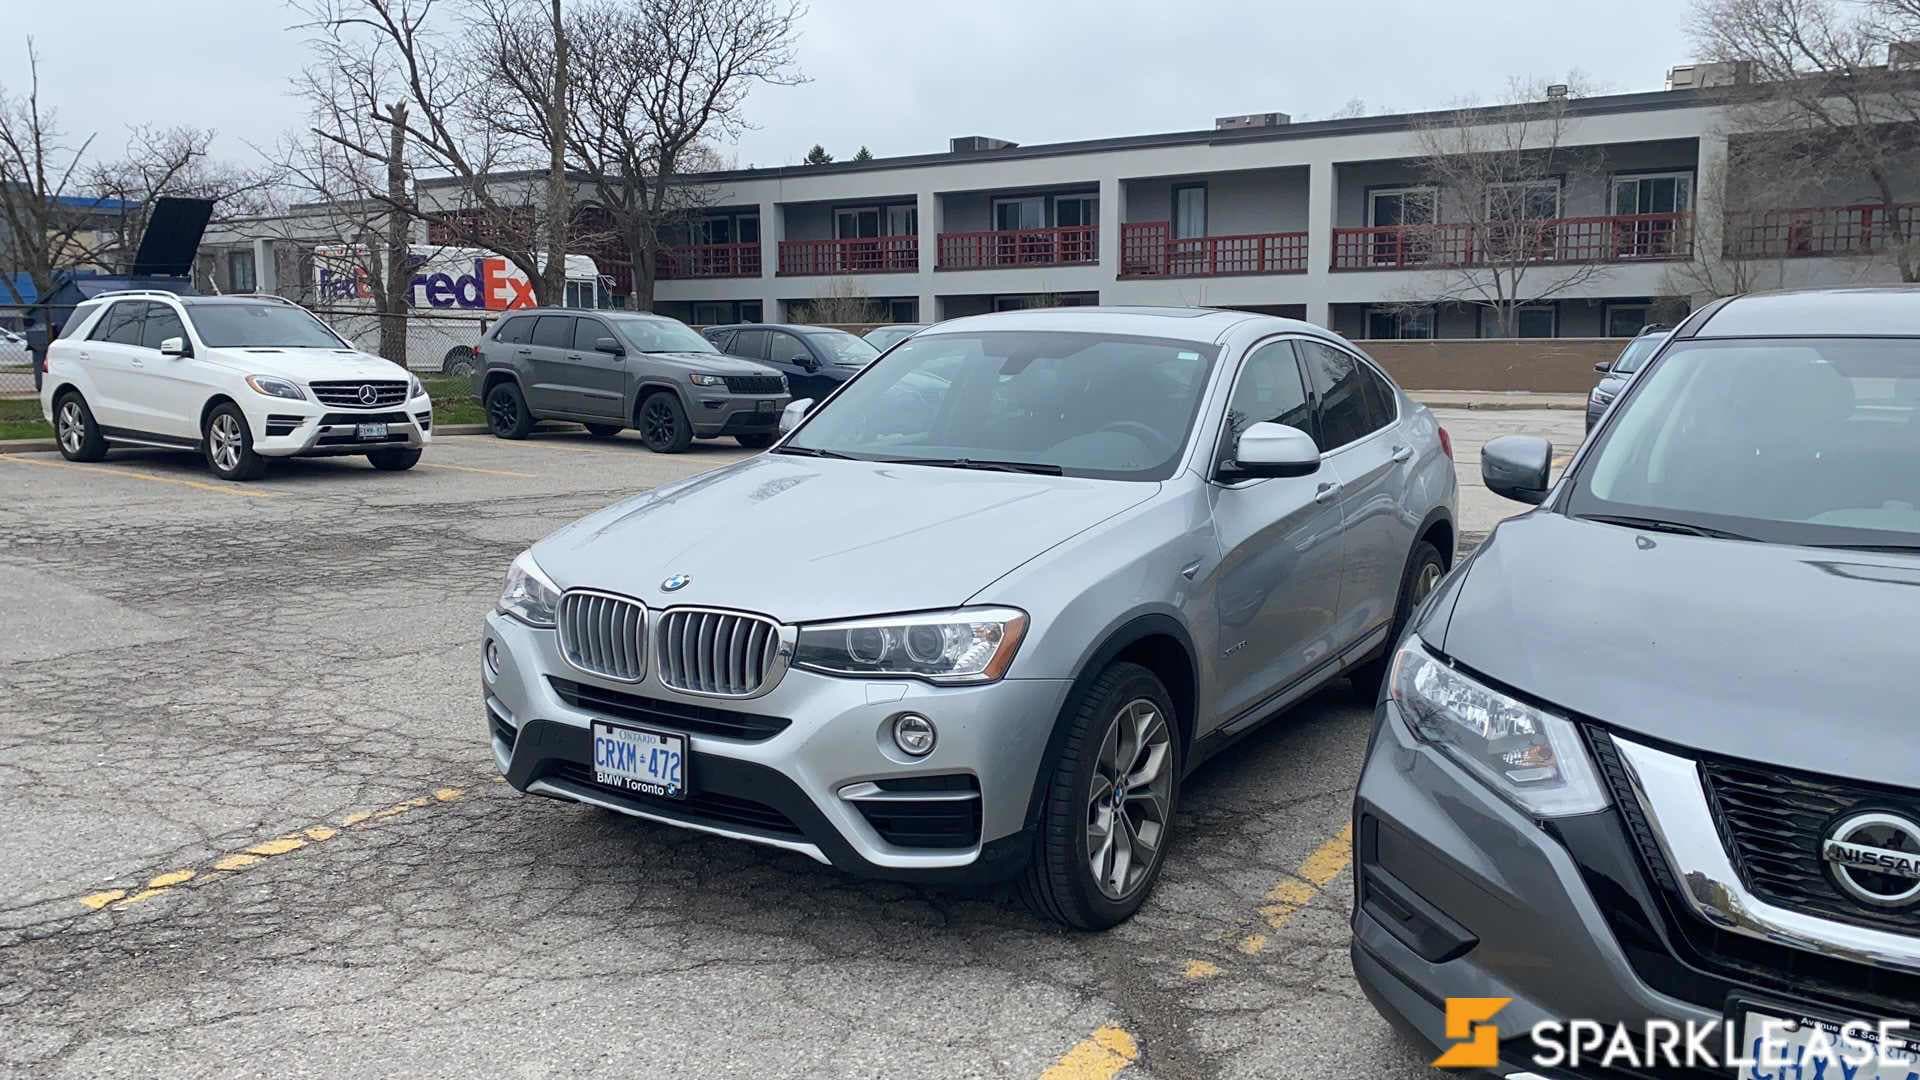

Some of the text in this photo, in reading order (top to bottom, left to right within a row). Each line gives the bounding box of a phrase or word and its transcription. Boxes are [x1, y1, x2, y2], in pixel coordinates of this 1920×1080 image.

[319, 265, 376, 300] FedE
[619, 731, 657, 745] ONTARIO
[595, 736, 681, 783] CRXM 472
[597, 772, 665, 796] BMW Toronto
